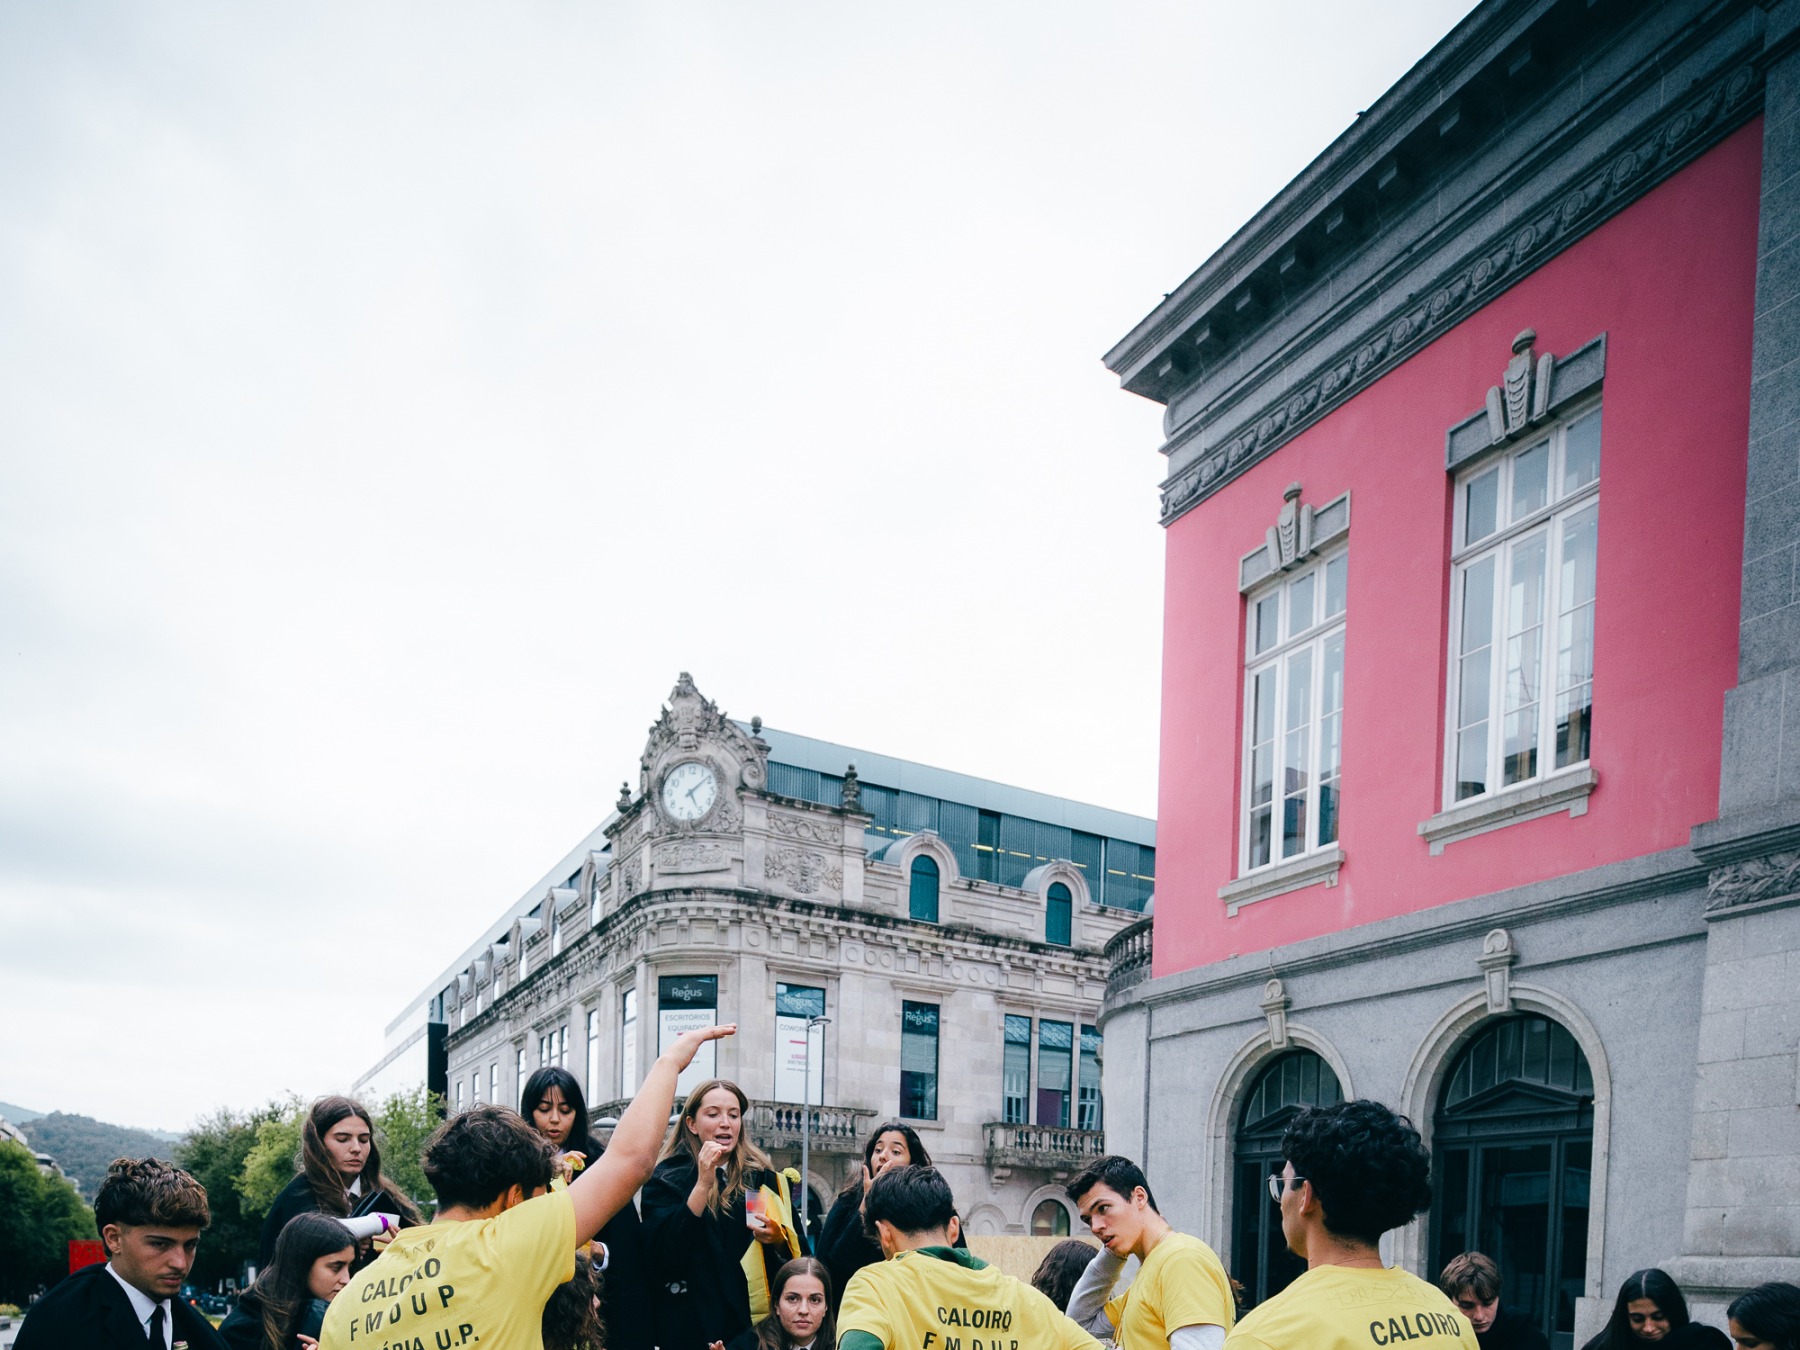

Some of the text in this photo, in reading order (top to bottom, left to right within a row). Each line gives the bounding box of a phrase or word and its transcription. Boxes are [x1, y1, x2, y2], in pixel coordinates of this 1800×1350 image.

[671, 986, 703, 1001] Regus
[784, 994, 813, 1010] Regus
[905, 1010, 933, 1025] Regus
[780, 1024, 820, 1035] COWORKNG
[361, 1257, 441, 1303] CALORO
[937, 1306, 1012, 1330] CALOIRO
[435, 1323, 479, 1350] U.P.
[1369, 1312, 1461, 1346] CALOIRO
